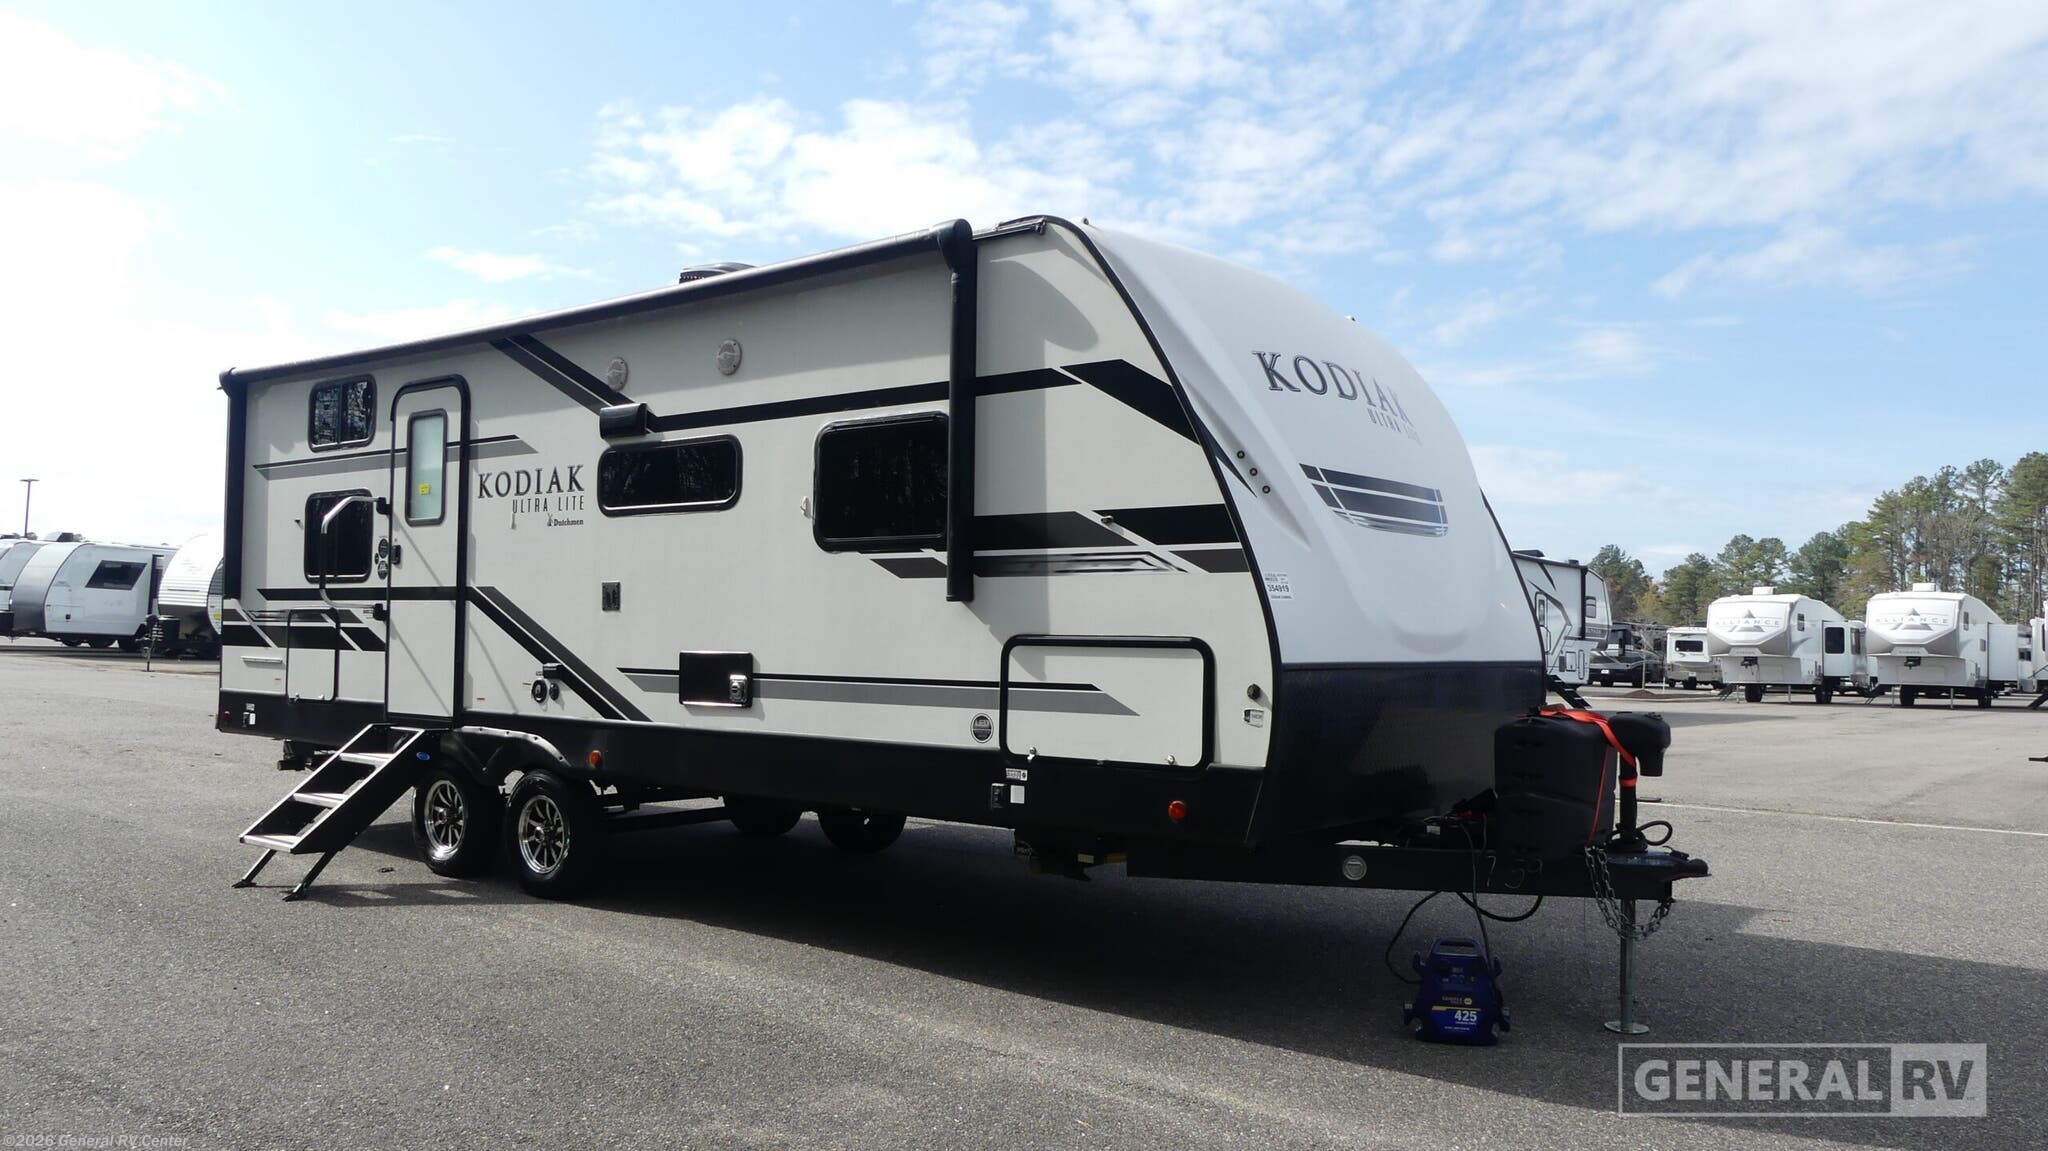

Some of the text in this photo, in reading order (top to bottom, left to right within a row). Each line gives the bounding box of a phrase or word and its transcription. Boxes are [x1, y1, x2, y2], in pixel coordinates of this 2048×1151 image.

[1252, 350, 1414, 427] KODIAK
[477, 464, 584, 499] KODIAK
[512, 496, 584, 514] ULTRA LITE
[553, 518, 584, 527] Dutchmen
[1876, 616, 1949, 624] ALLIANCE
[1454, 1010, 1477, 1022] 425
